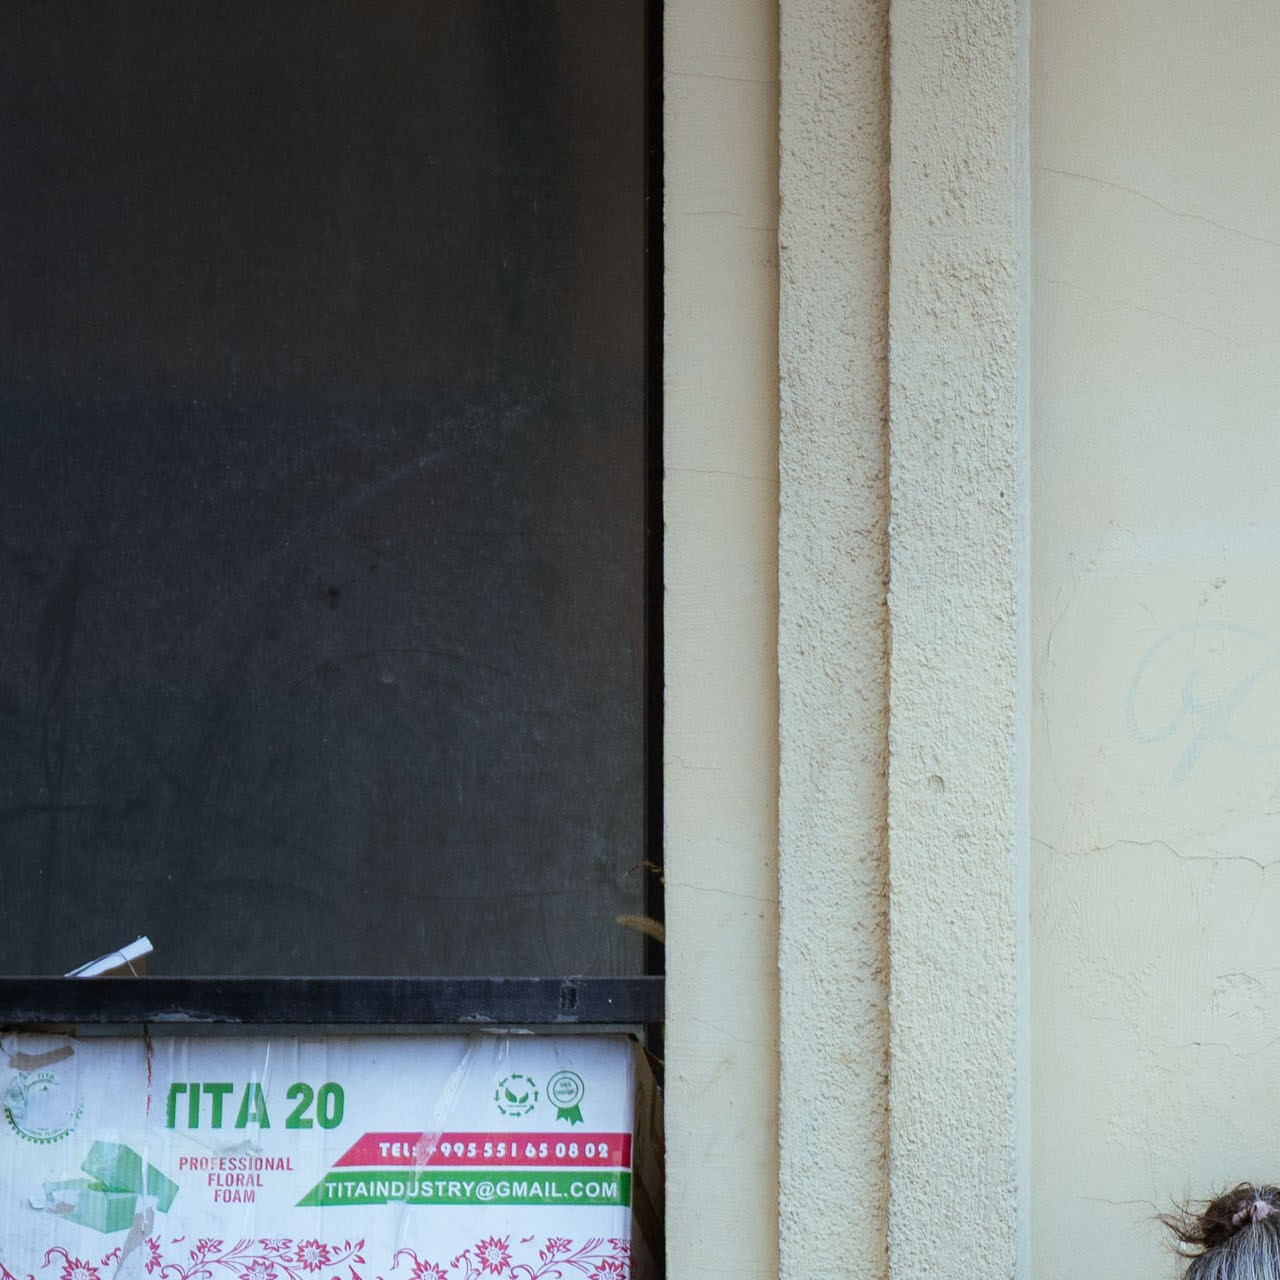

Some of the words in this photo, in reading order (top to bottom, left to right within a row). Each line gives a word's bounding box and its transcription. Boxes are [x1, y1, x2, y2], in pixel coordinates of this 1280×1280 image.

[167, 1082, 271, 1129] TITA
[285, 1082, 345, 1129] 20
[379, 1142, 418, 1157] TEL:
[483, 1142, 517, 1157] 551
[525, 1142, 548, 1157] 65
[556, 1142, 578, 1157] 08
[585, 1142, 609, 1158] 02
[178, 1156, 294, 1171] PROFESSIONAL
[208, 1172, 264, 1187] FLORAL
[214, 1189, 255, 1203] FOAM
[325, 1180, 618, 1201] TITAINDUSTRY@GMAIL.COM
